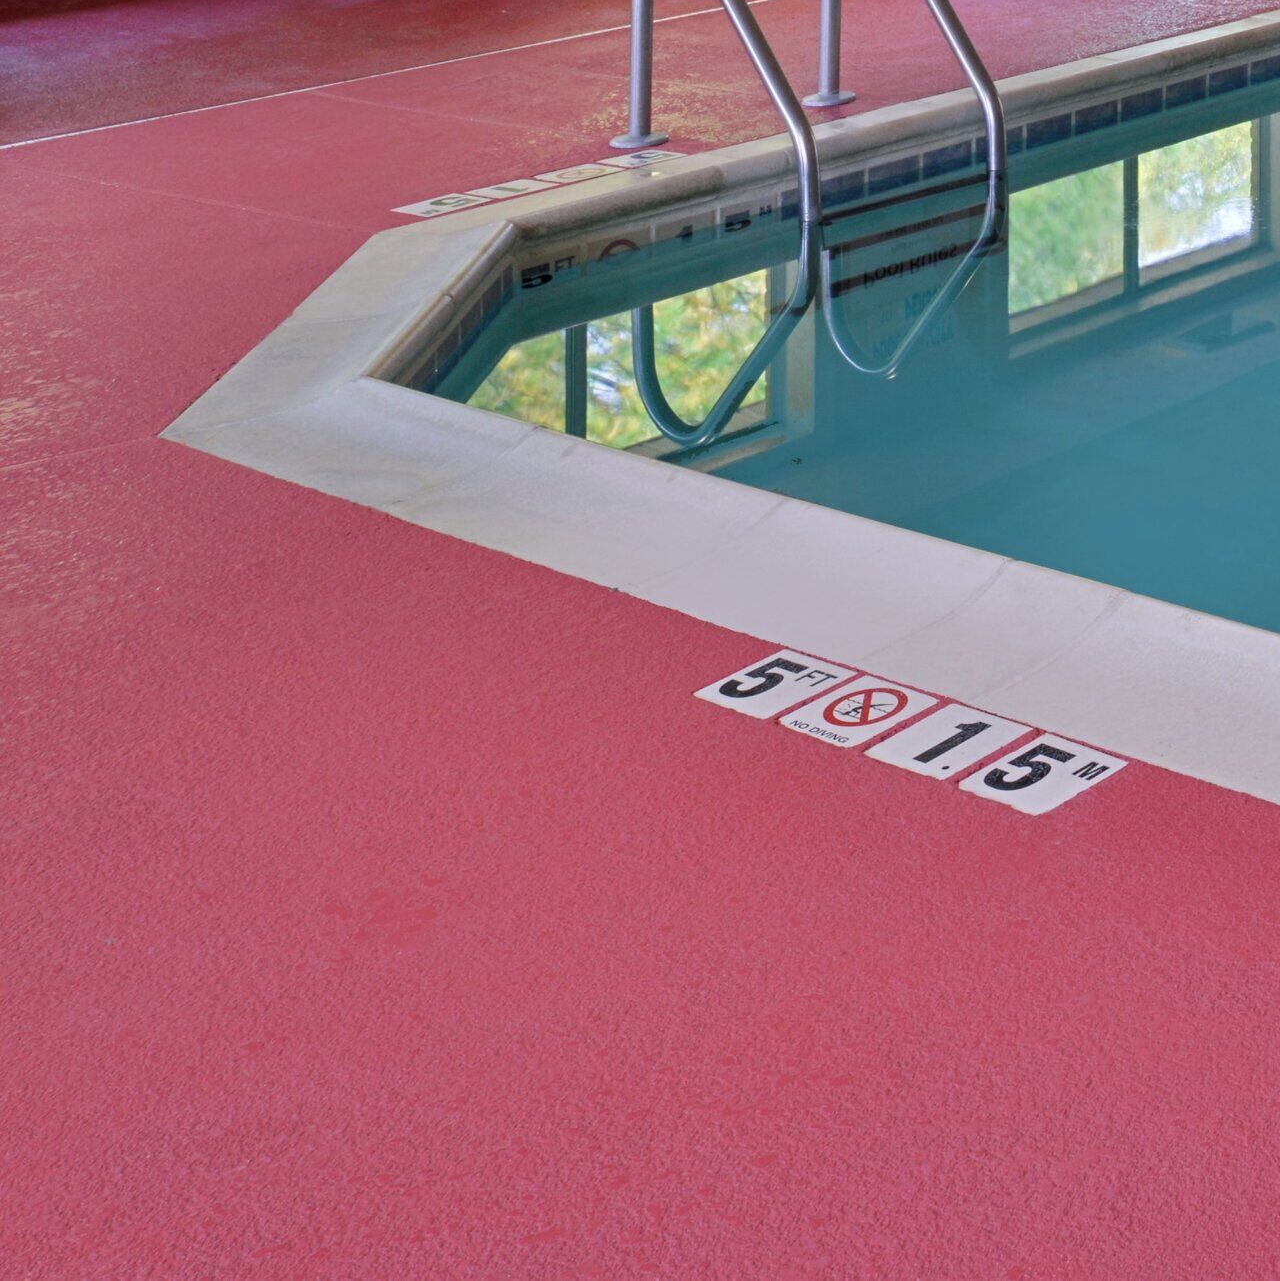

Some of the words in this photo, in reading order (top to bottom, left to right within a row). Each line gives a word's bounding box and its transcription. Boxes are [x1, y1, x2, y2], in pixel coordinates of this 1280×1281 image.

[718, 657, 810, 699] 5
[794, 668, 839, 688] FT
[789, 720, 810, 729] NO
[808, 726, 850, 744] DIVING
[1072, 761, 1111, 781] M
